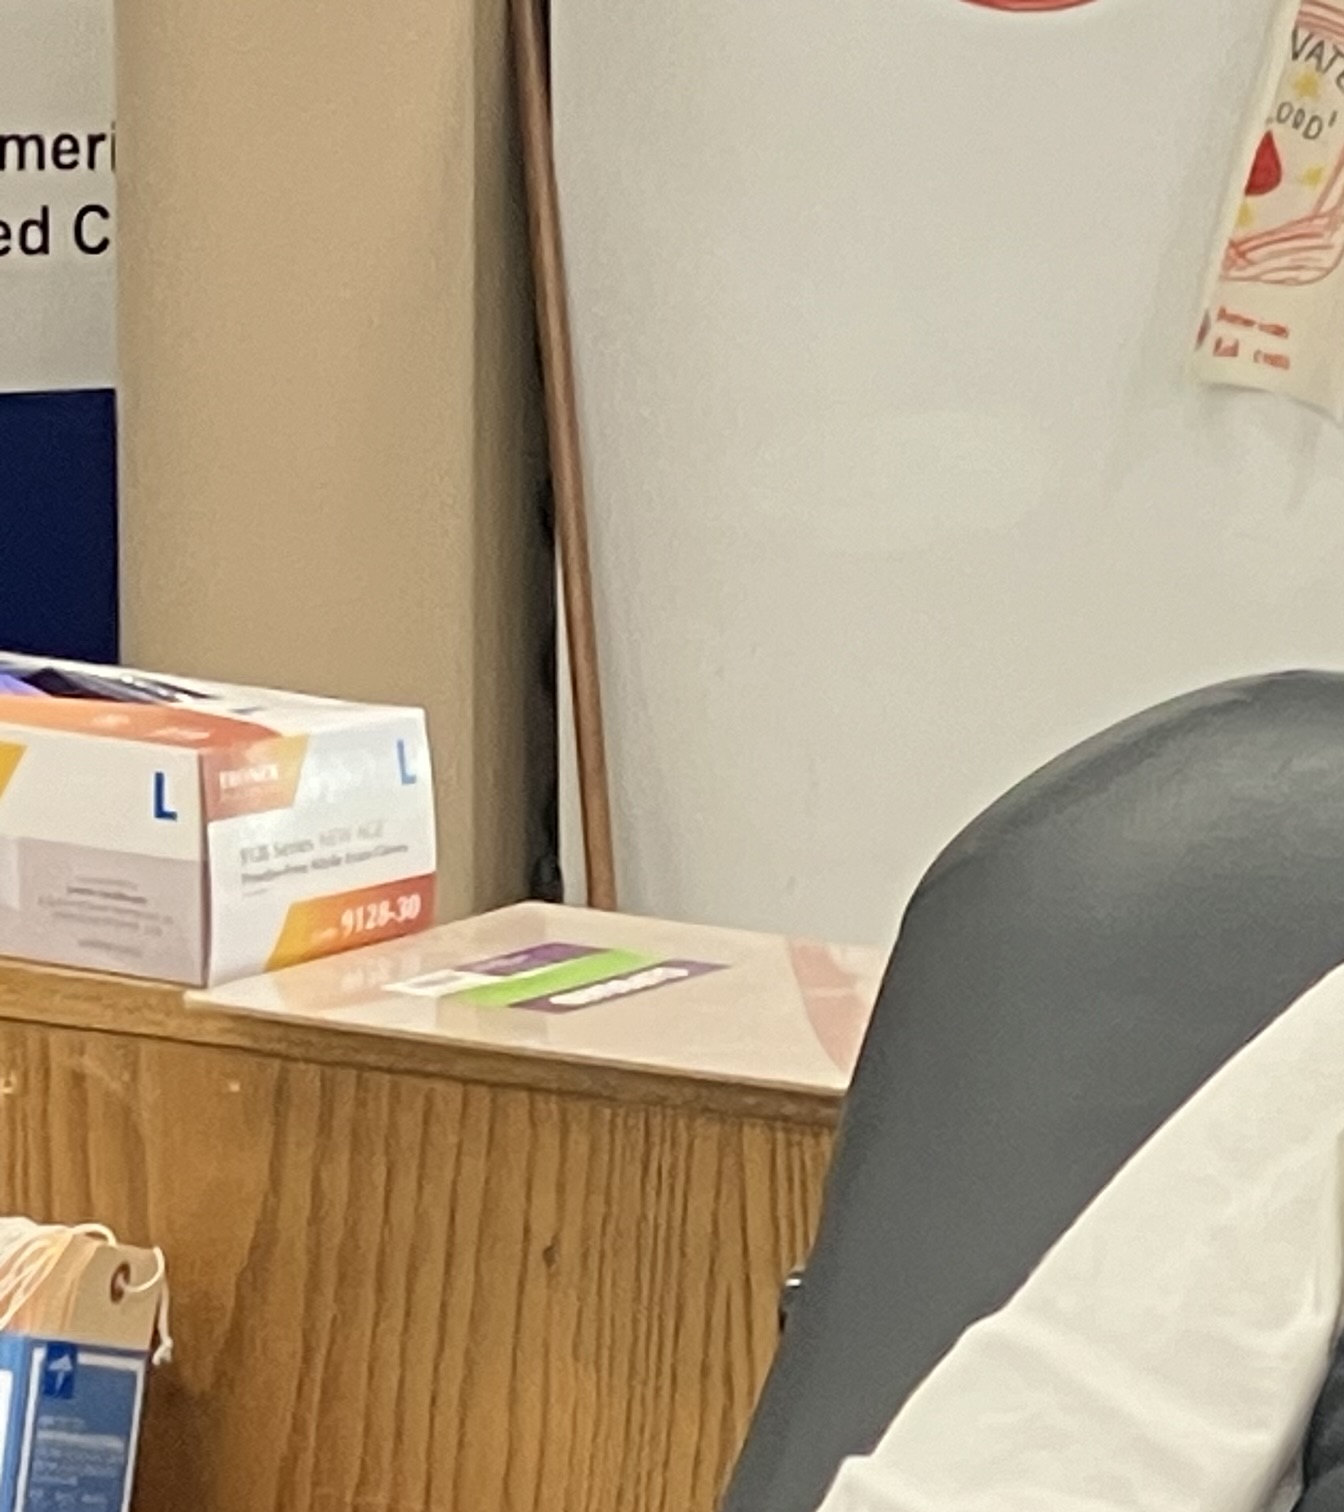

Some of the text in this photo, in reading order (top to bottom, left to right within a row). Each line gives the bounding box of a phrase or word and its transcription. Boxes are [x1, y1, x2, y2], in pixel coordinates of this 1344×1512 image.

[397, 740, 416, 784] L
[155, 772, 177, 821] L
[341, 893, 421, 938] 9128-30
